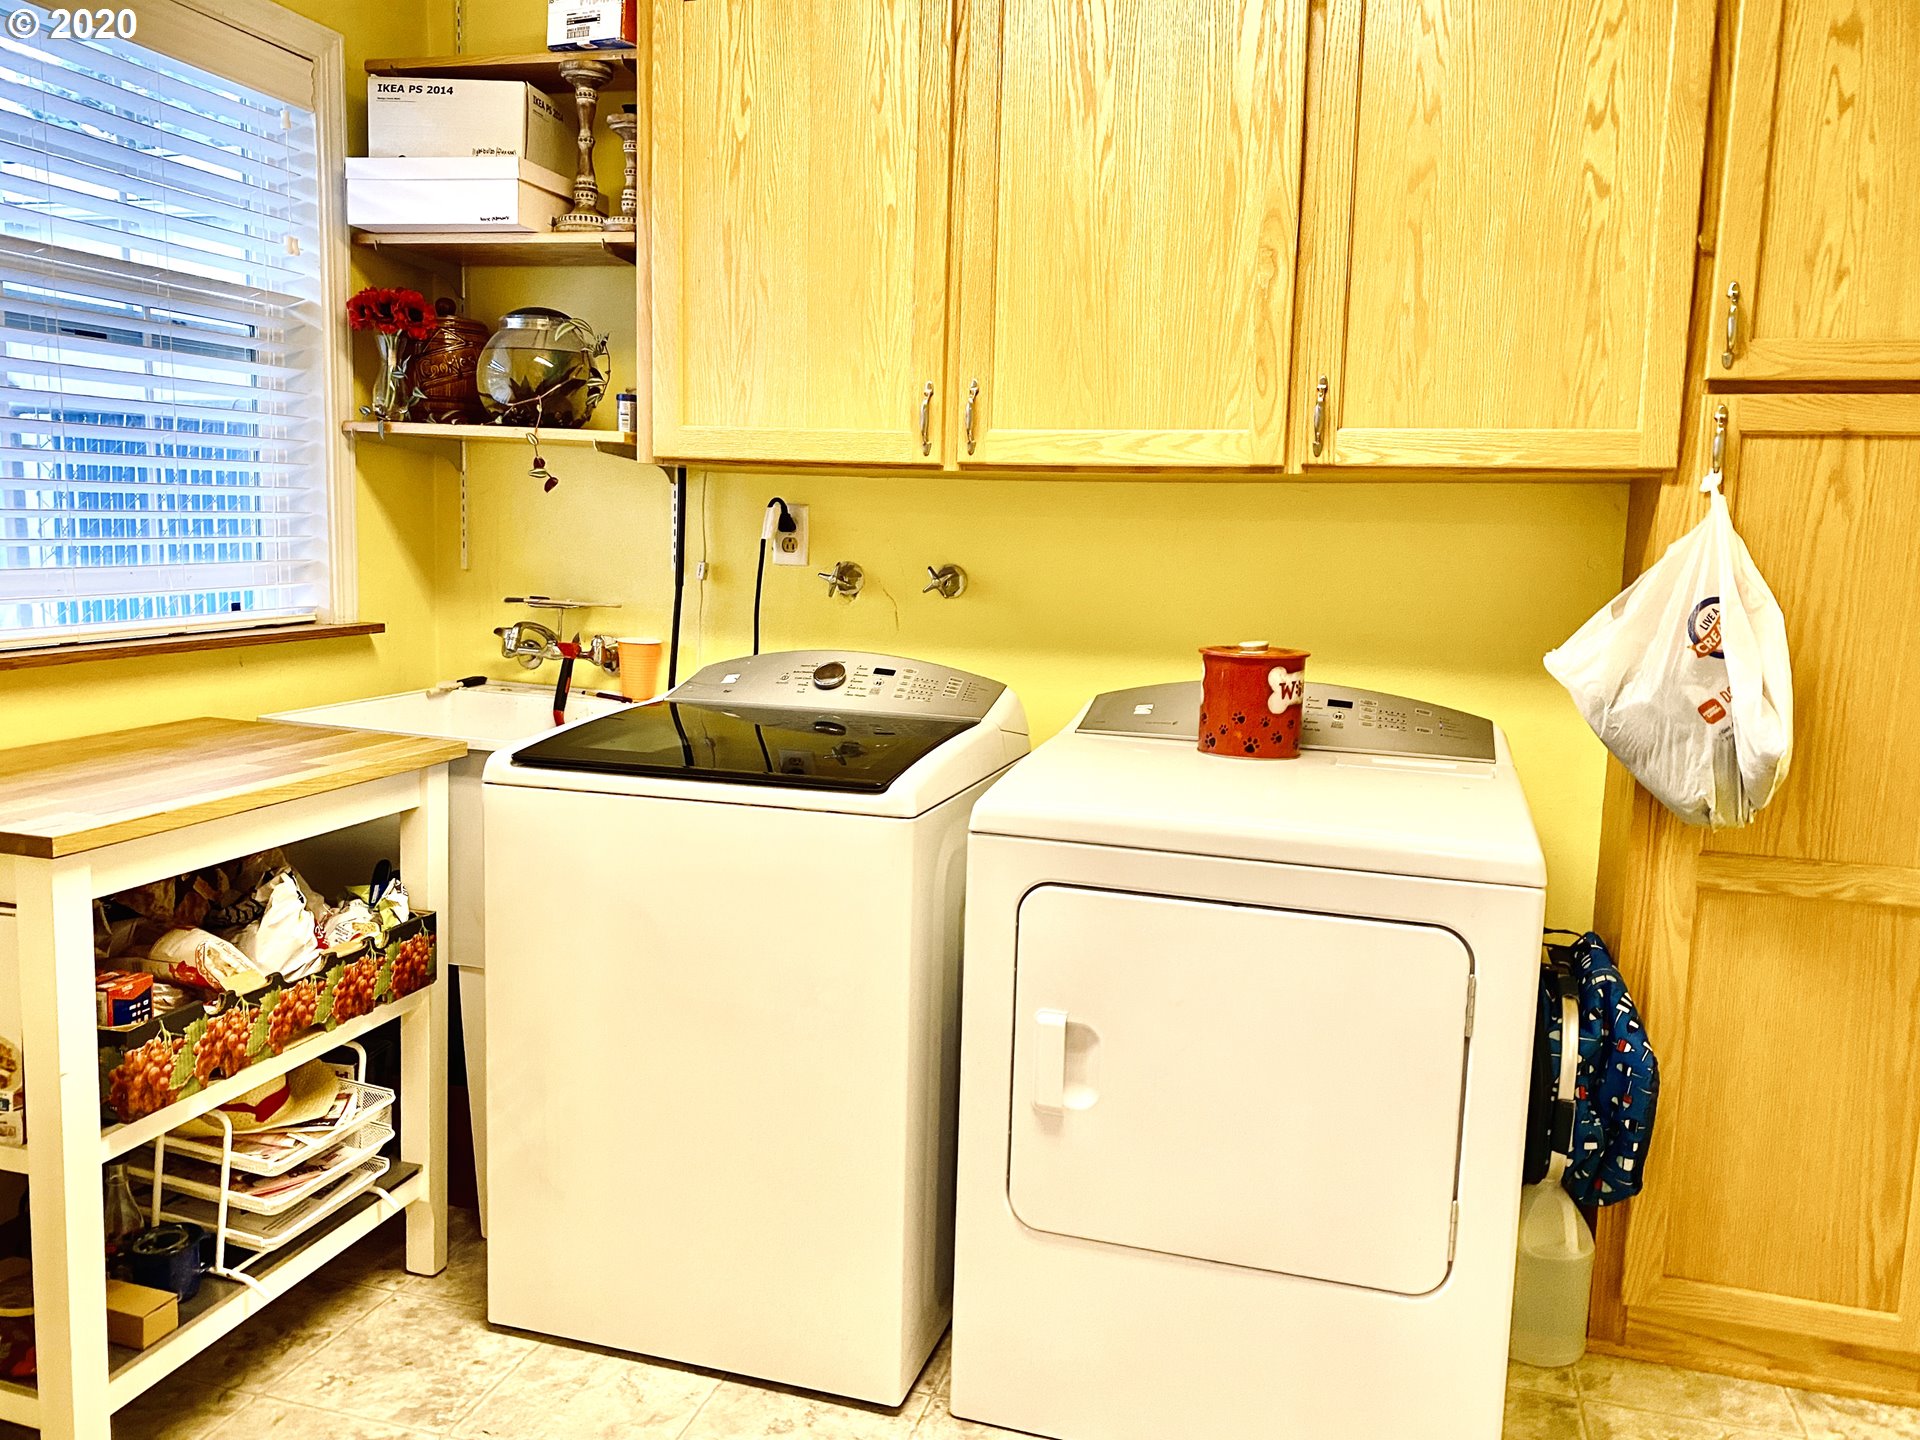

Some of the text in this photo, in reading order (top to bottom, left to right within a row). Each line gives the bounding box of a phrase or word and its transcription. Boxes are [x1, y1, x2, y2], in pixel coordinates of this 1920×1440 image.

[377, 83, 454, 95] IKEA PS 2014
[533, 95, 546, 111] IKEA
[1699, 608, 1720, 631] LIVE A
